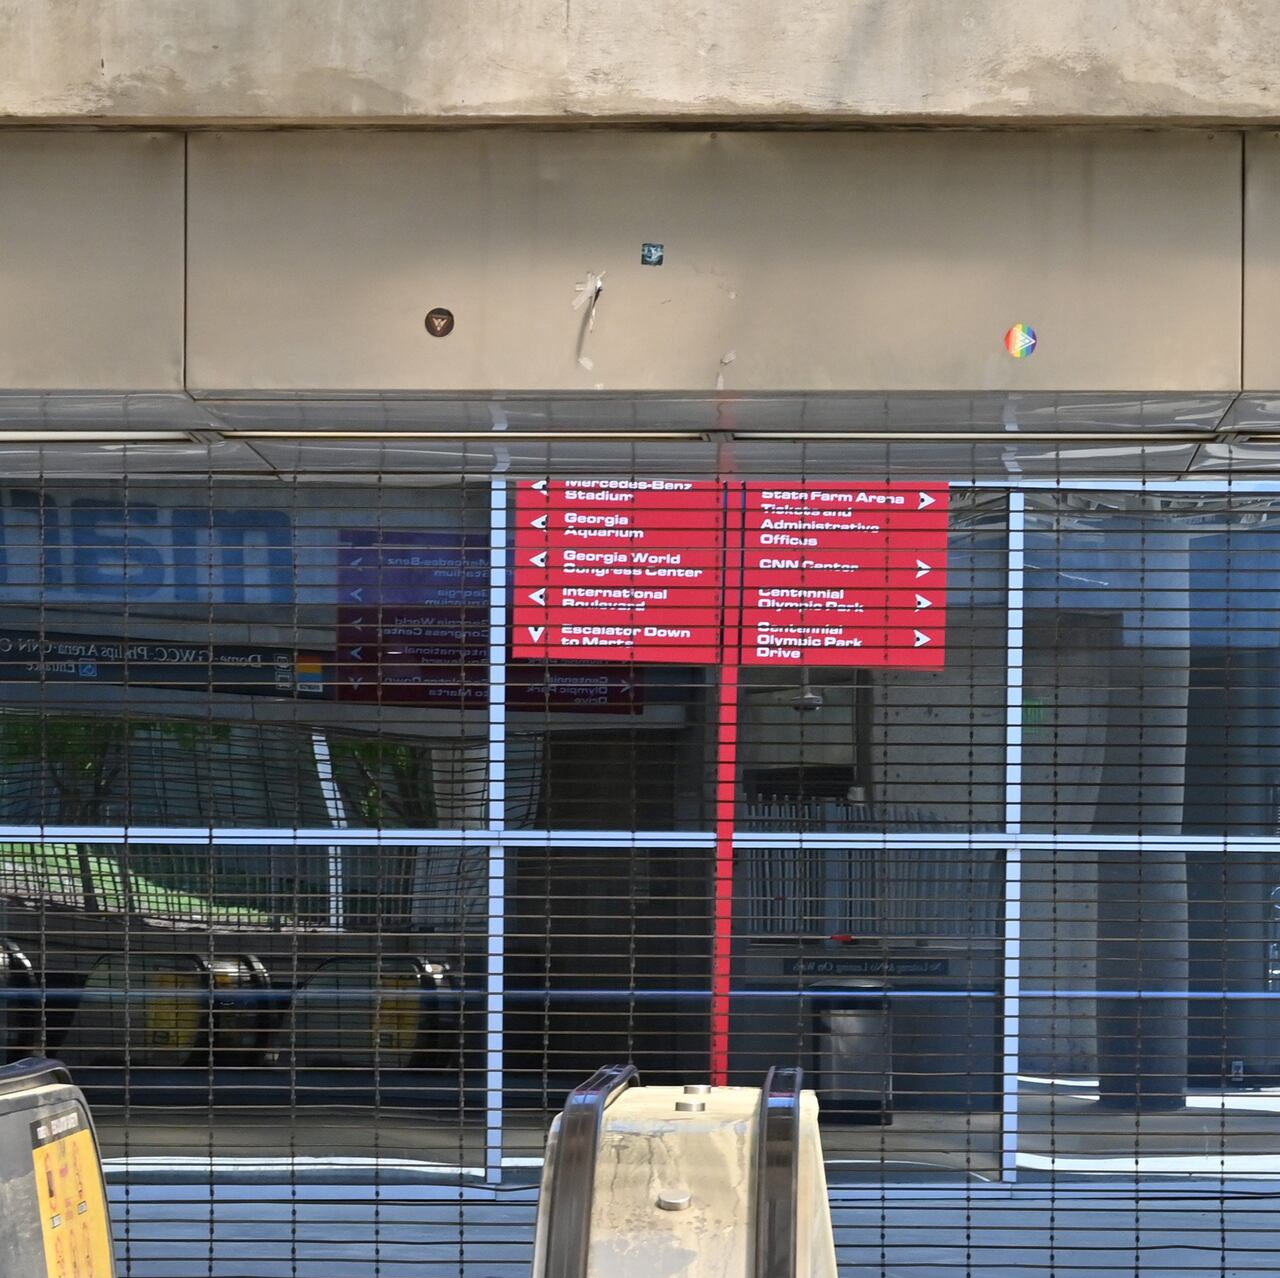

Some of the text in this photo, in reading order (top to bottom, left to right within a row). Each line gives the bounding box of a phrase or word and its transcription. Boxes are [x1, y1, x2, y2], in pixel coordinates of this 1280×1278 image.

[565, 480, 692, 490] Mercedes-Benz
[565, 490, 634, 501] Stadium
[811, 491, 853, 503] Farm
[855, 492, 905, 504] Arena
[564, 512, 629, 527] Georgia
[563, 525, 644, 538] Aquarium
[760, 519, 880, 533] Administrative
[760, 534, 818, 546] Offices
[563, 550, 681, 565] Georgia World
[759, 558, 799, 569] CNN
[645, 566, 703, 577] Center
[562, 588, 668, 599] International
[758, 588, 845, 599] Centennial
[757, 599, 865, 613] Olympic Park
[561, 624, 690, 638] Escalator Down
[561, 637, 634, 649] to Marta
[757, 634, 863, 647] Olympic Park
[756, 647, 801, 659] Drive
